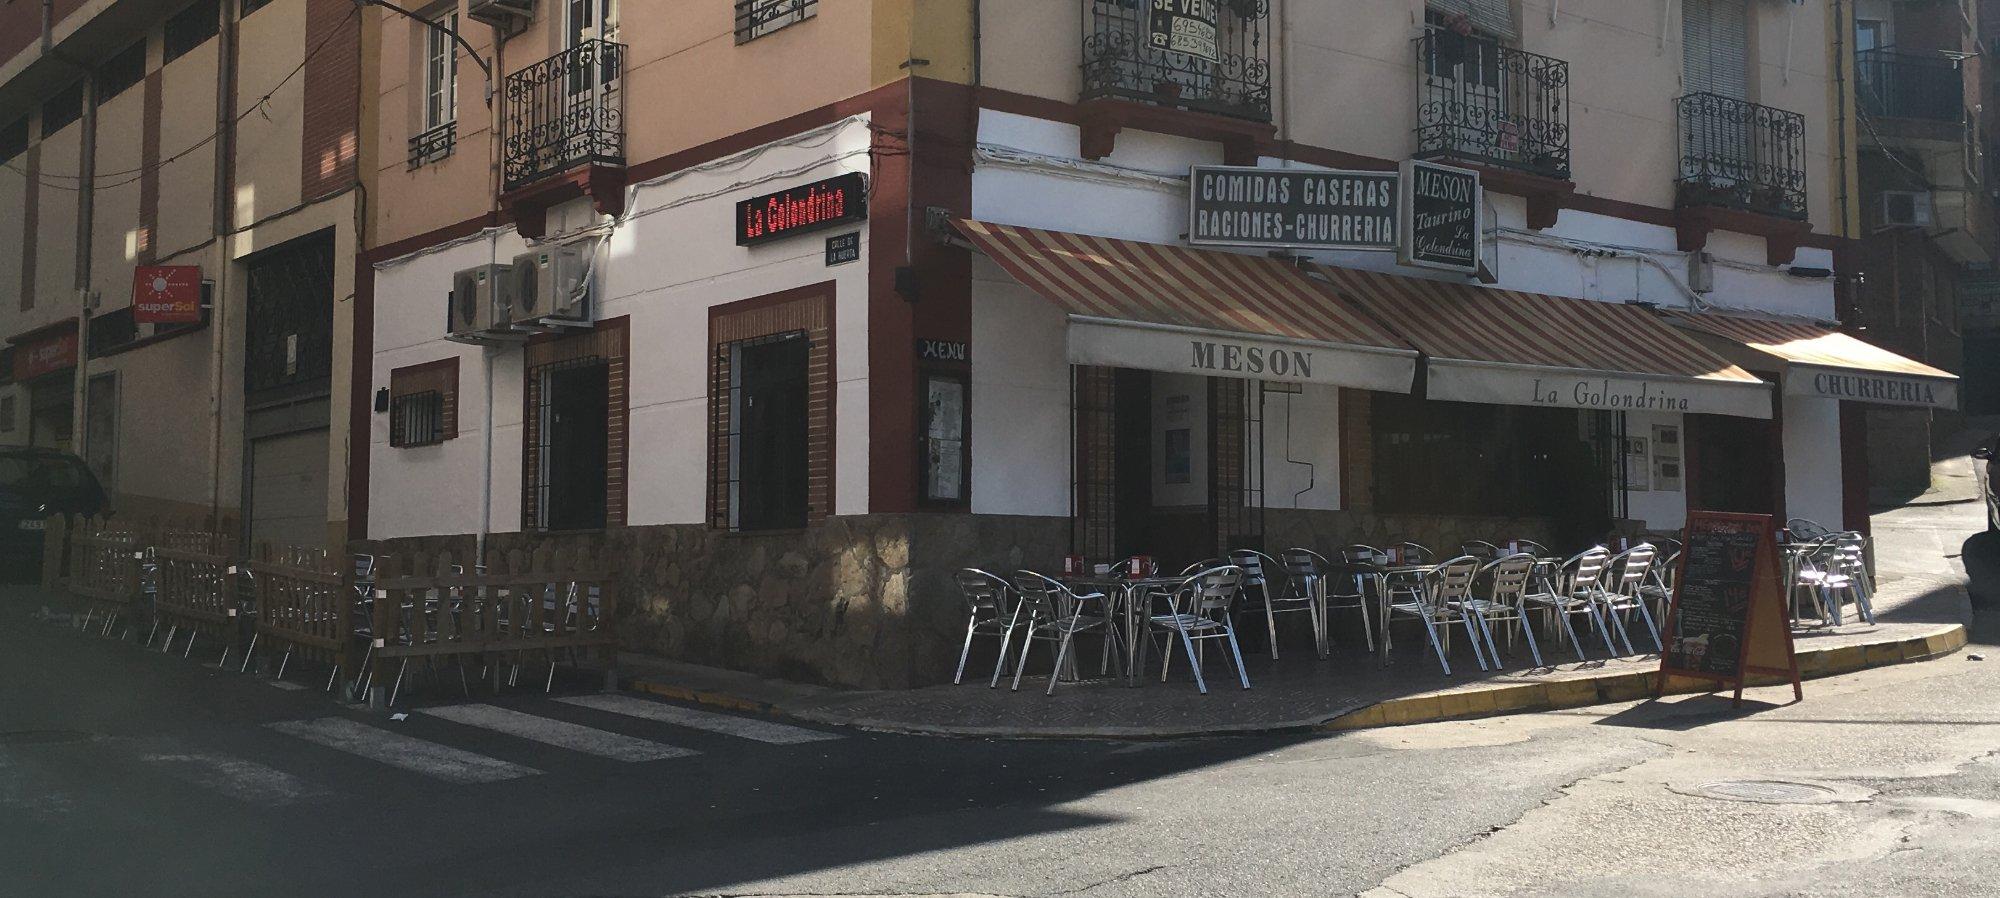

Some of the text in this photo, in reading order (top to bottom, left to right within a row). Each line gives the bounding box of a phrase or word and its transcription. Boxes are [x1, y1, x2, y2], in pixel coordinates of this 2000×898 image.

[1181, 0, 1216, 25] VENDE
[1203, 174, 1390, 208] COMIDAS CASERAS
[1416, 171, 1472, 203] MESON
[746, 184, 845, 238] La Golondrina
[1416, 207, 1471, 230] Taurino
[1416, 235, 1471, 258] Golondrina
[1454, 224, 1470, 240] La
[923, 340, 966, 361] MENU
[1191, 341, 1312, 378] MESON
[1532, 378, 1689, 411] La Golondrina
[1814, 372, 1936, 404] CHURRERIA
